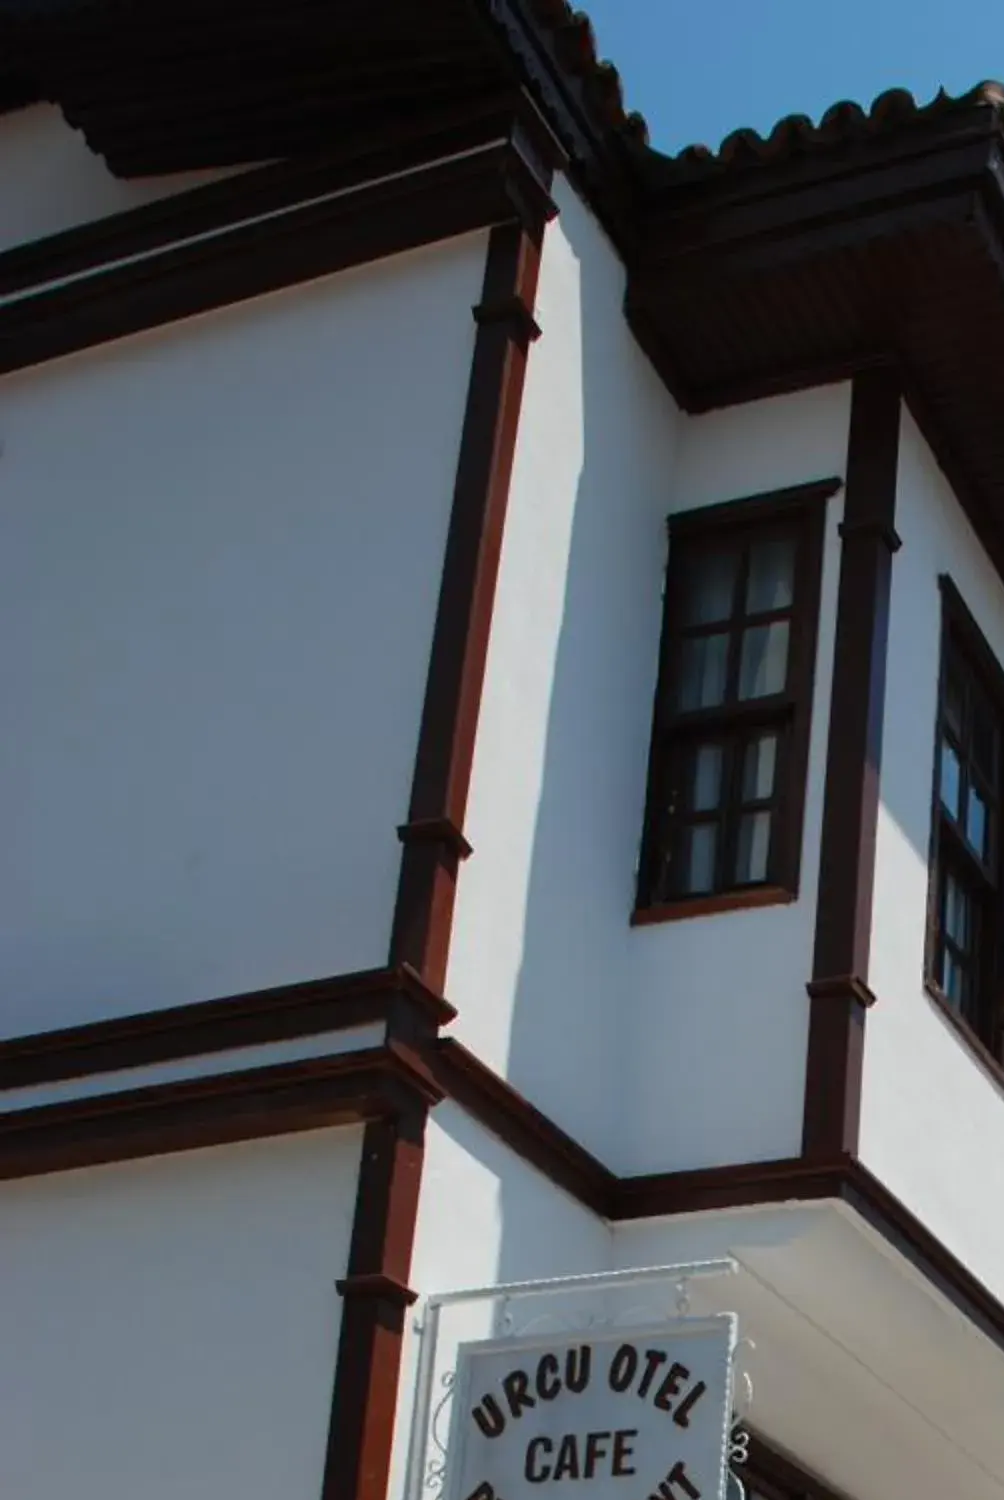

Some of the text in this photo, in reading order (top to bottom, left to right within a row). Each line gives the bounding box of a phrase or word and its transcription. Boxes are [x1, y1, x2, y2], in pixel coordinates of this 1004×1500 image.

[471, 1343, 707, 1438] URCU OTEL
[524, 1429, 638, 1483] CAFE
